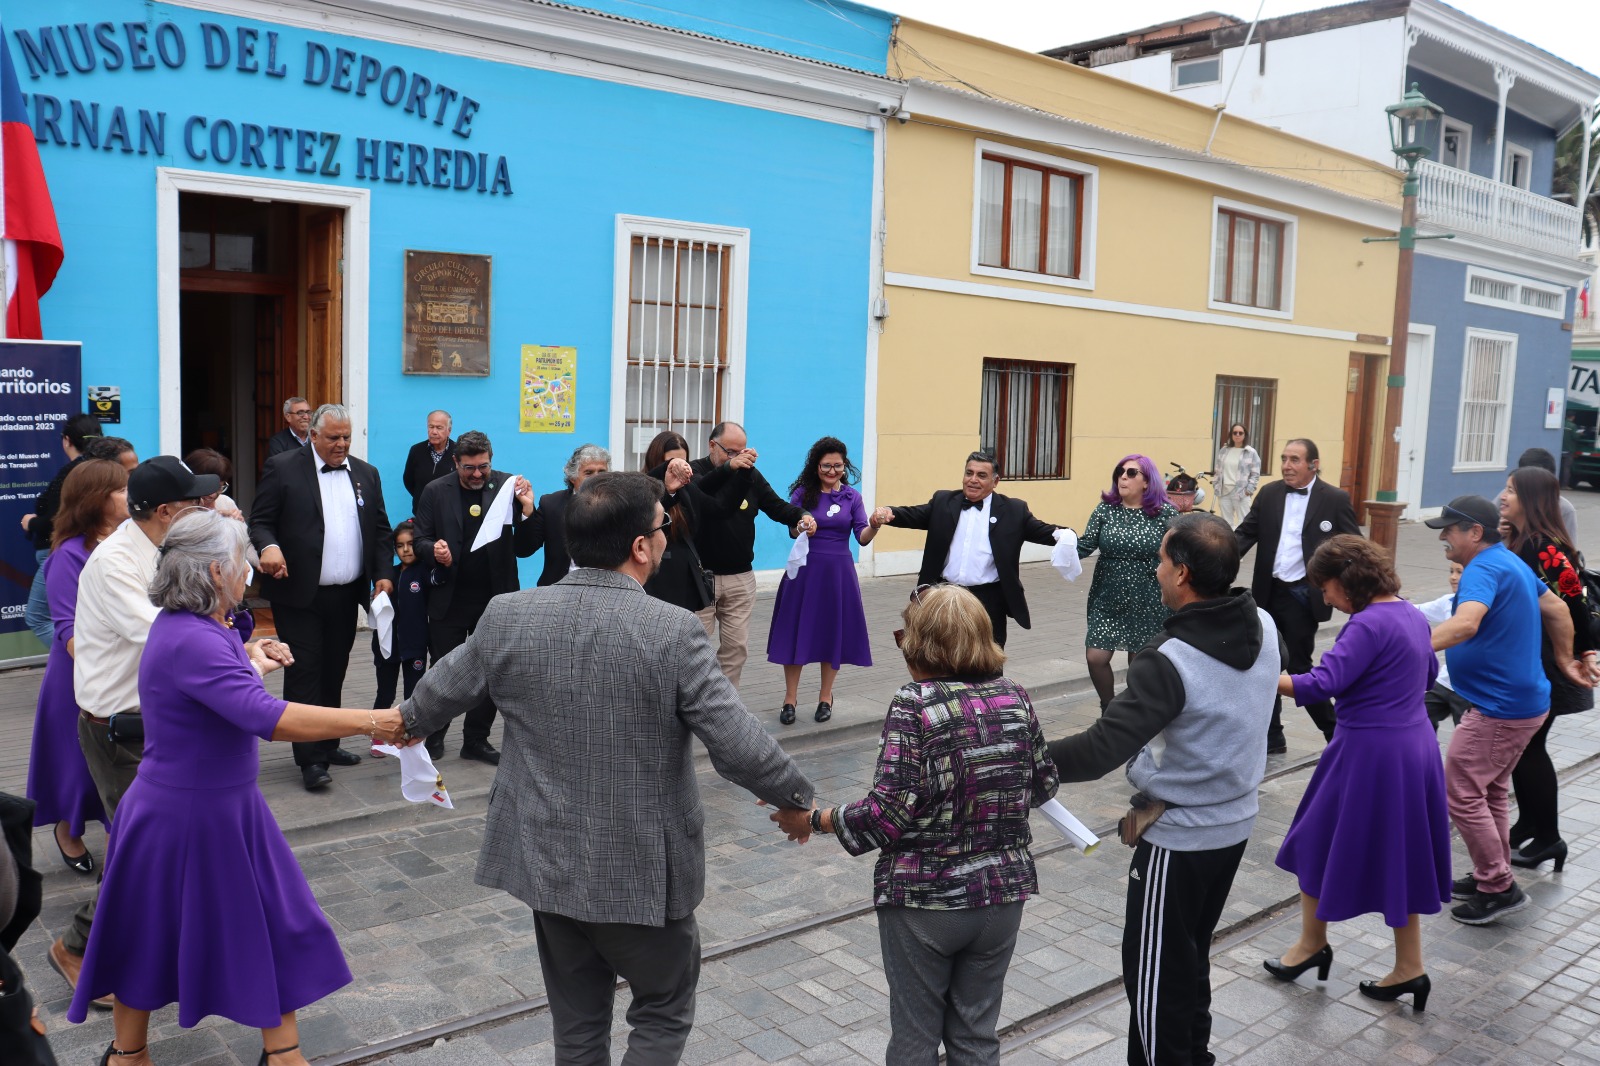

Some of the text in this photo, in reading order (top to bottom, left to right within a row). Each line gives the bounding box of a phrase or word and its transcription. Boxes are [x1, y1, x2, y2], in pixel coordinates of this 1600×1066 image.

[14, 21, 481, 139] MUSEO DEL DEPORTE
[21, 92, 514, 195] RNAN CORTEZ HEREDIA
[413, 260, 482, 287] CIRCULO CULTURAL
[426, 269, 469, 285] DEPORTIVO
[412, 324, 485, 336] MUSEO DEL DEPORTE
[0, 367, 34, 378] ando
[1571, 365, 1600, 395] TA
[44, 413, 68, 421] FNDR
[35, 422, 55, 430] 2023
[1, 604, 28, 614] CORE
